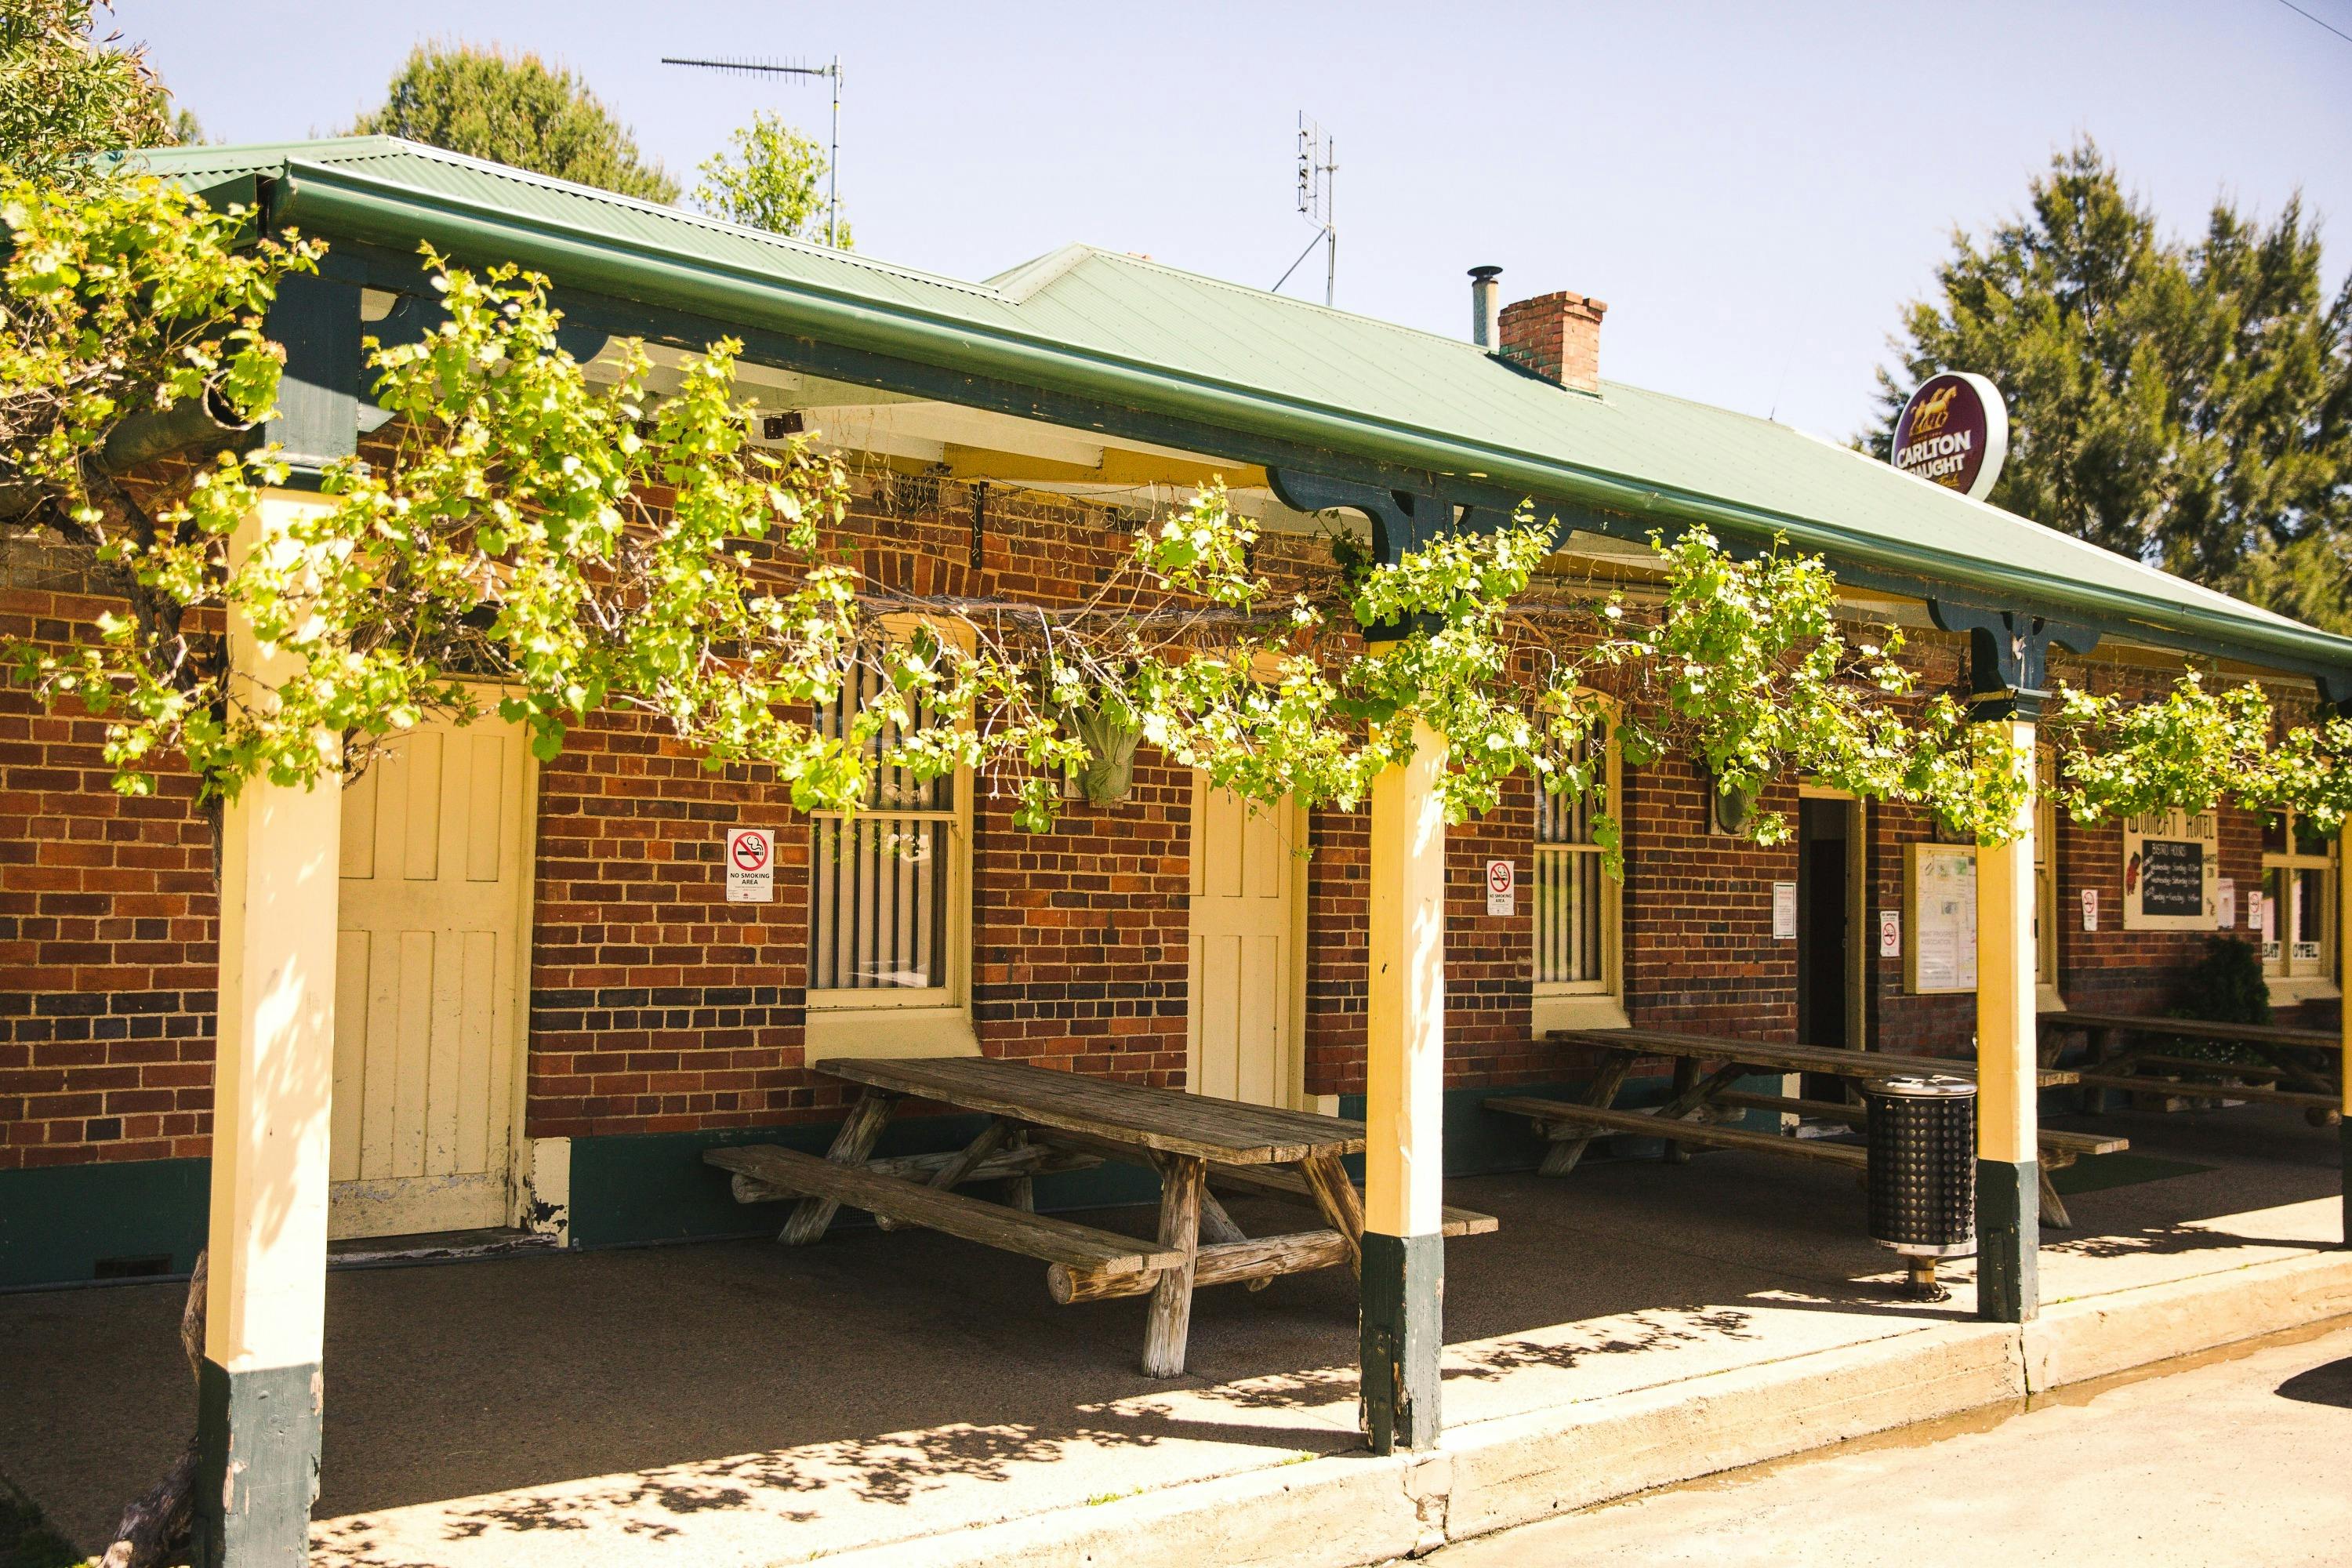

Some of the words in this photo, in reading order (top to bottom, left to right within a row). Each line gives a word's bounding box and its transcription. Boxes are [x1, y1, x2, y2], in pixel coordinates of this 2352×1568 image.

[1896, 430, 1971, 469] CARLTON
[1904, 453, 1965, 479] AUGHT
[2186, 815, 2214, 840] HOTEL
